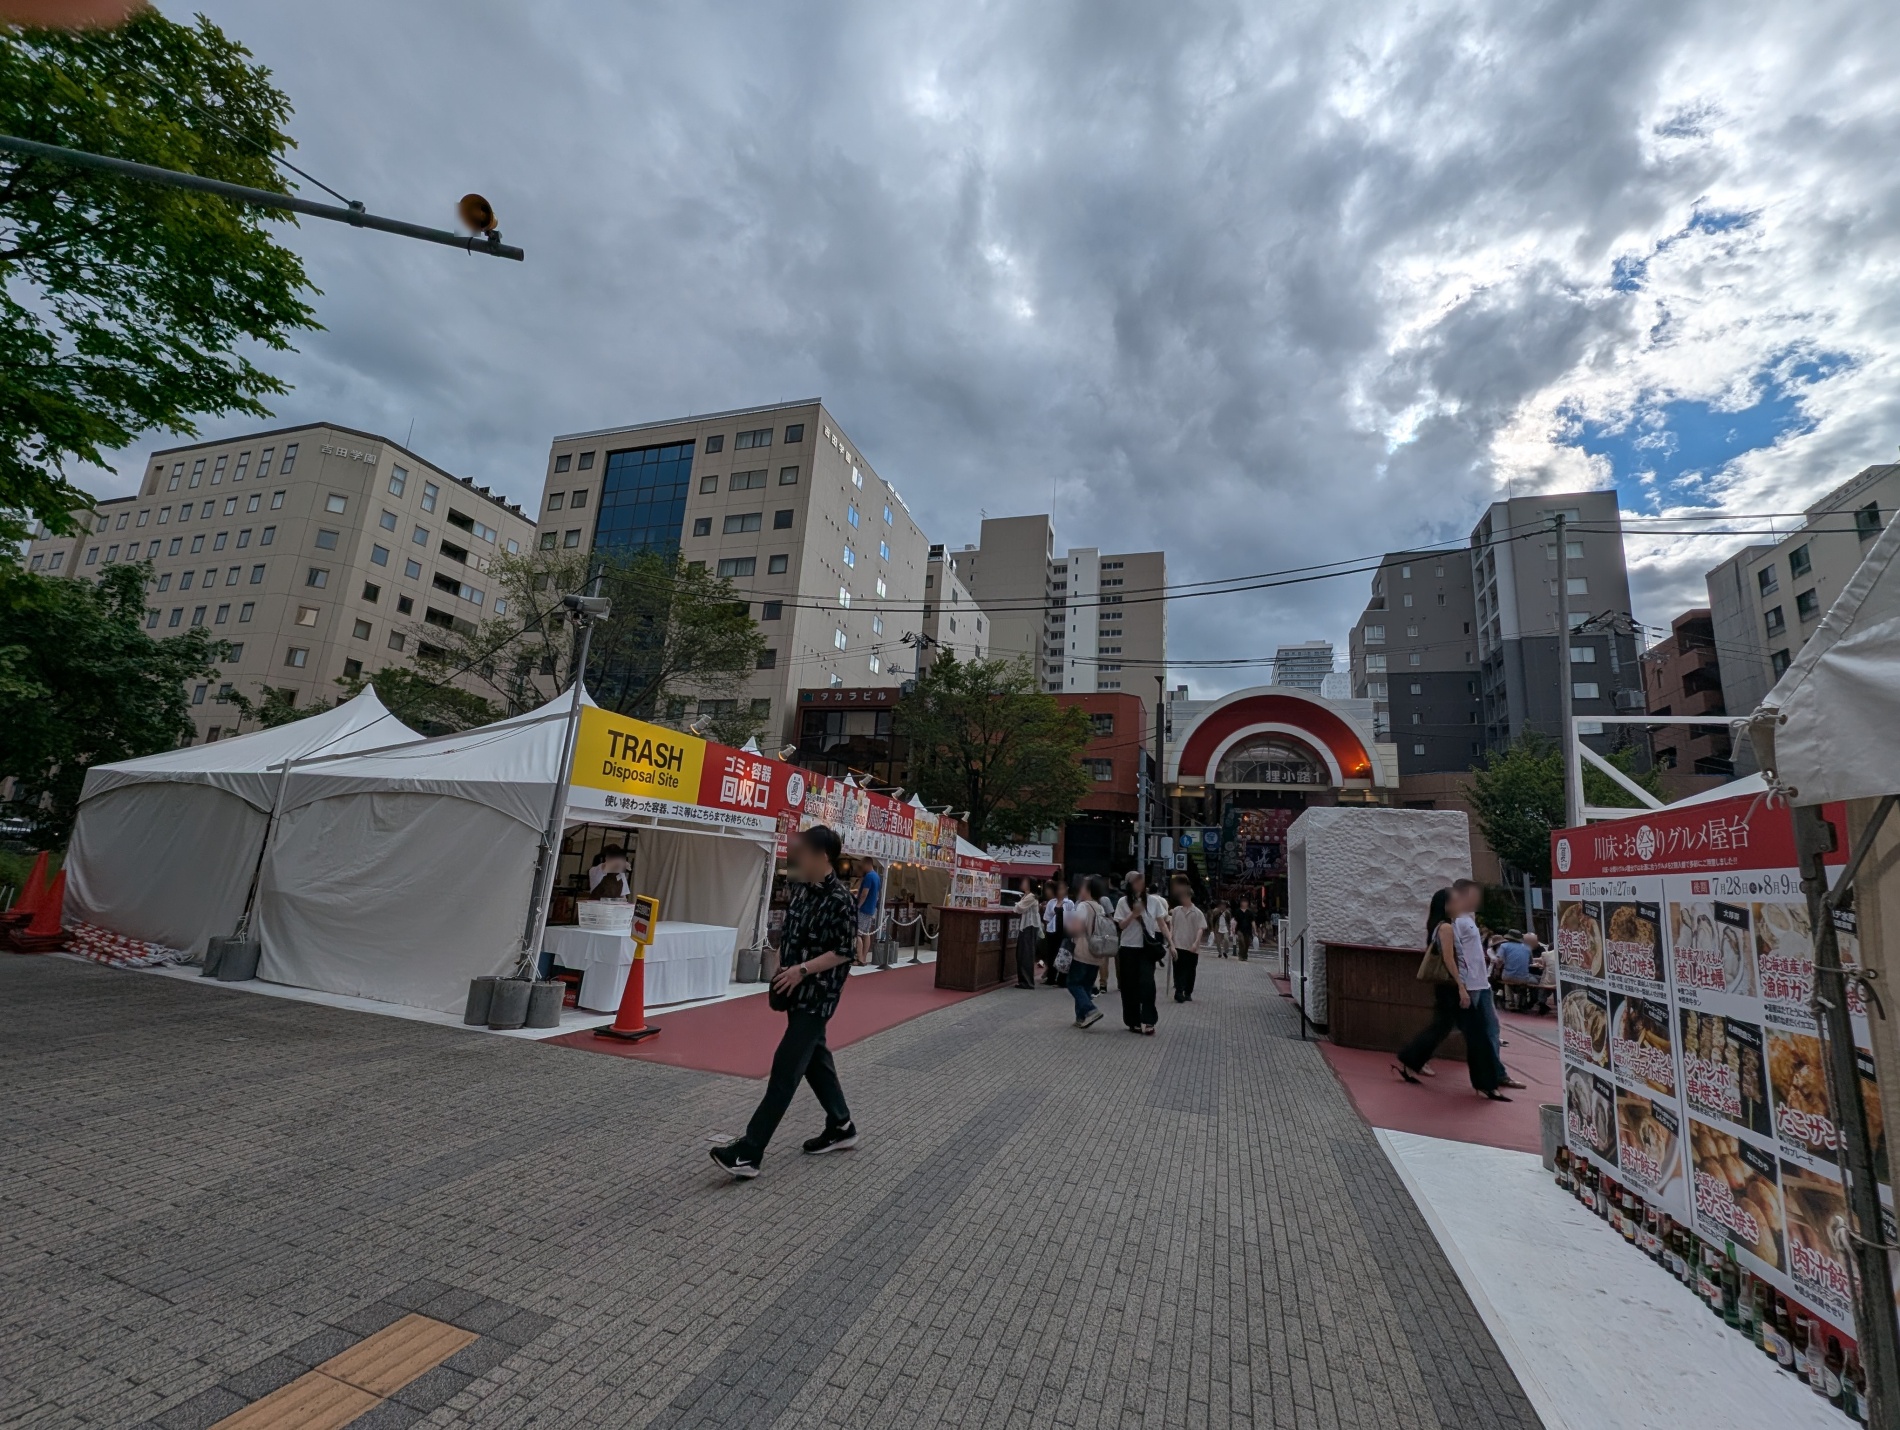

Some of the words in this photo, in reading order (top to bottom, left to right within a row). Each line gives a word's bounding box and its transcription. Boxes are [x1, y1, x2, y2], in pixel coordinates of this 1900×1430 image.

[321, 443, 377, 465] 吉田学園
[820, 691, 887, 702] タカラビル
[607, 729, 684, 773] TRASH
[602, 760, 655, 785] Disposal
[657, 771, 679, 789] Site
[724, 755, 772, 783] ゴミ・容器
[1265, 770, 1320, 783] 狸小路1
[720, 775, 771, 810] 回収口
[1594, 815, 1750, 862] 川床・お祭りグルメ屋台
[1693, 881, 1708, 894] 後期
[1559, 946, 1584, 964] プレート
[1607, 955, 1656, 979] しいたけ焼き
[1759, 955, 1800, 973] 北海道産
[1677, 962, 1727, 991] 蒸し牡蠣
[1687, 1077, 1742, 1118] 串焼き各種
[1621, 1141, 1662, 1184] 肉汁餃子
[1695, 1168, 1734, 1203] 大阪なにわ
[1696, 1186, 1759, 1245] 大たこ焼き
